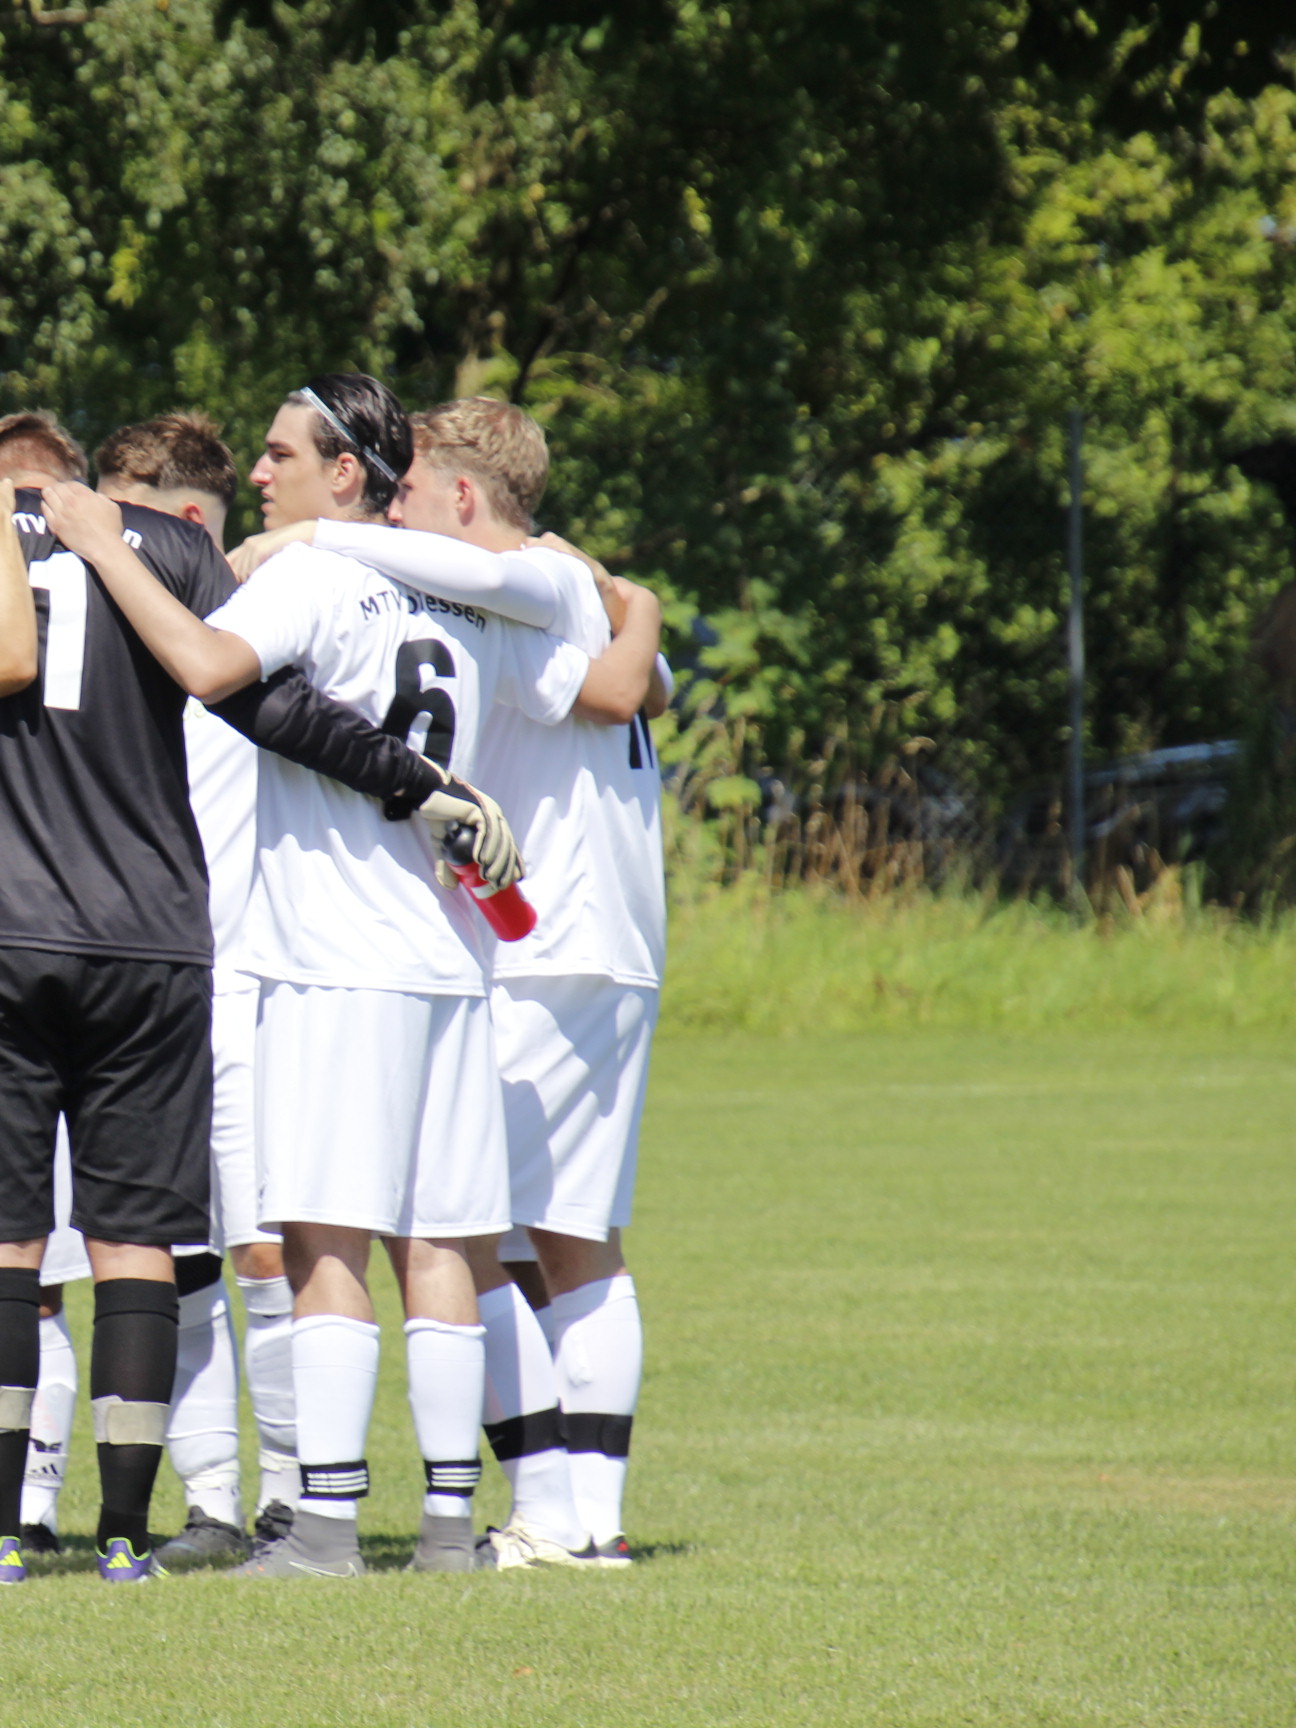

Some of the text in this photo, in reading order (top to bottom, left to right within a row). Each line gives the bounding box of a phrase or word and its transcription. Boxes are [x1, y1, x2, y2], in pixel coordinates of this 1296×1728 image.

[28, 551, 87, 711] 1
[359, 590, 403, 621] MTV
[380, 637, 457, 822] 6
